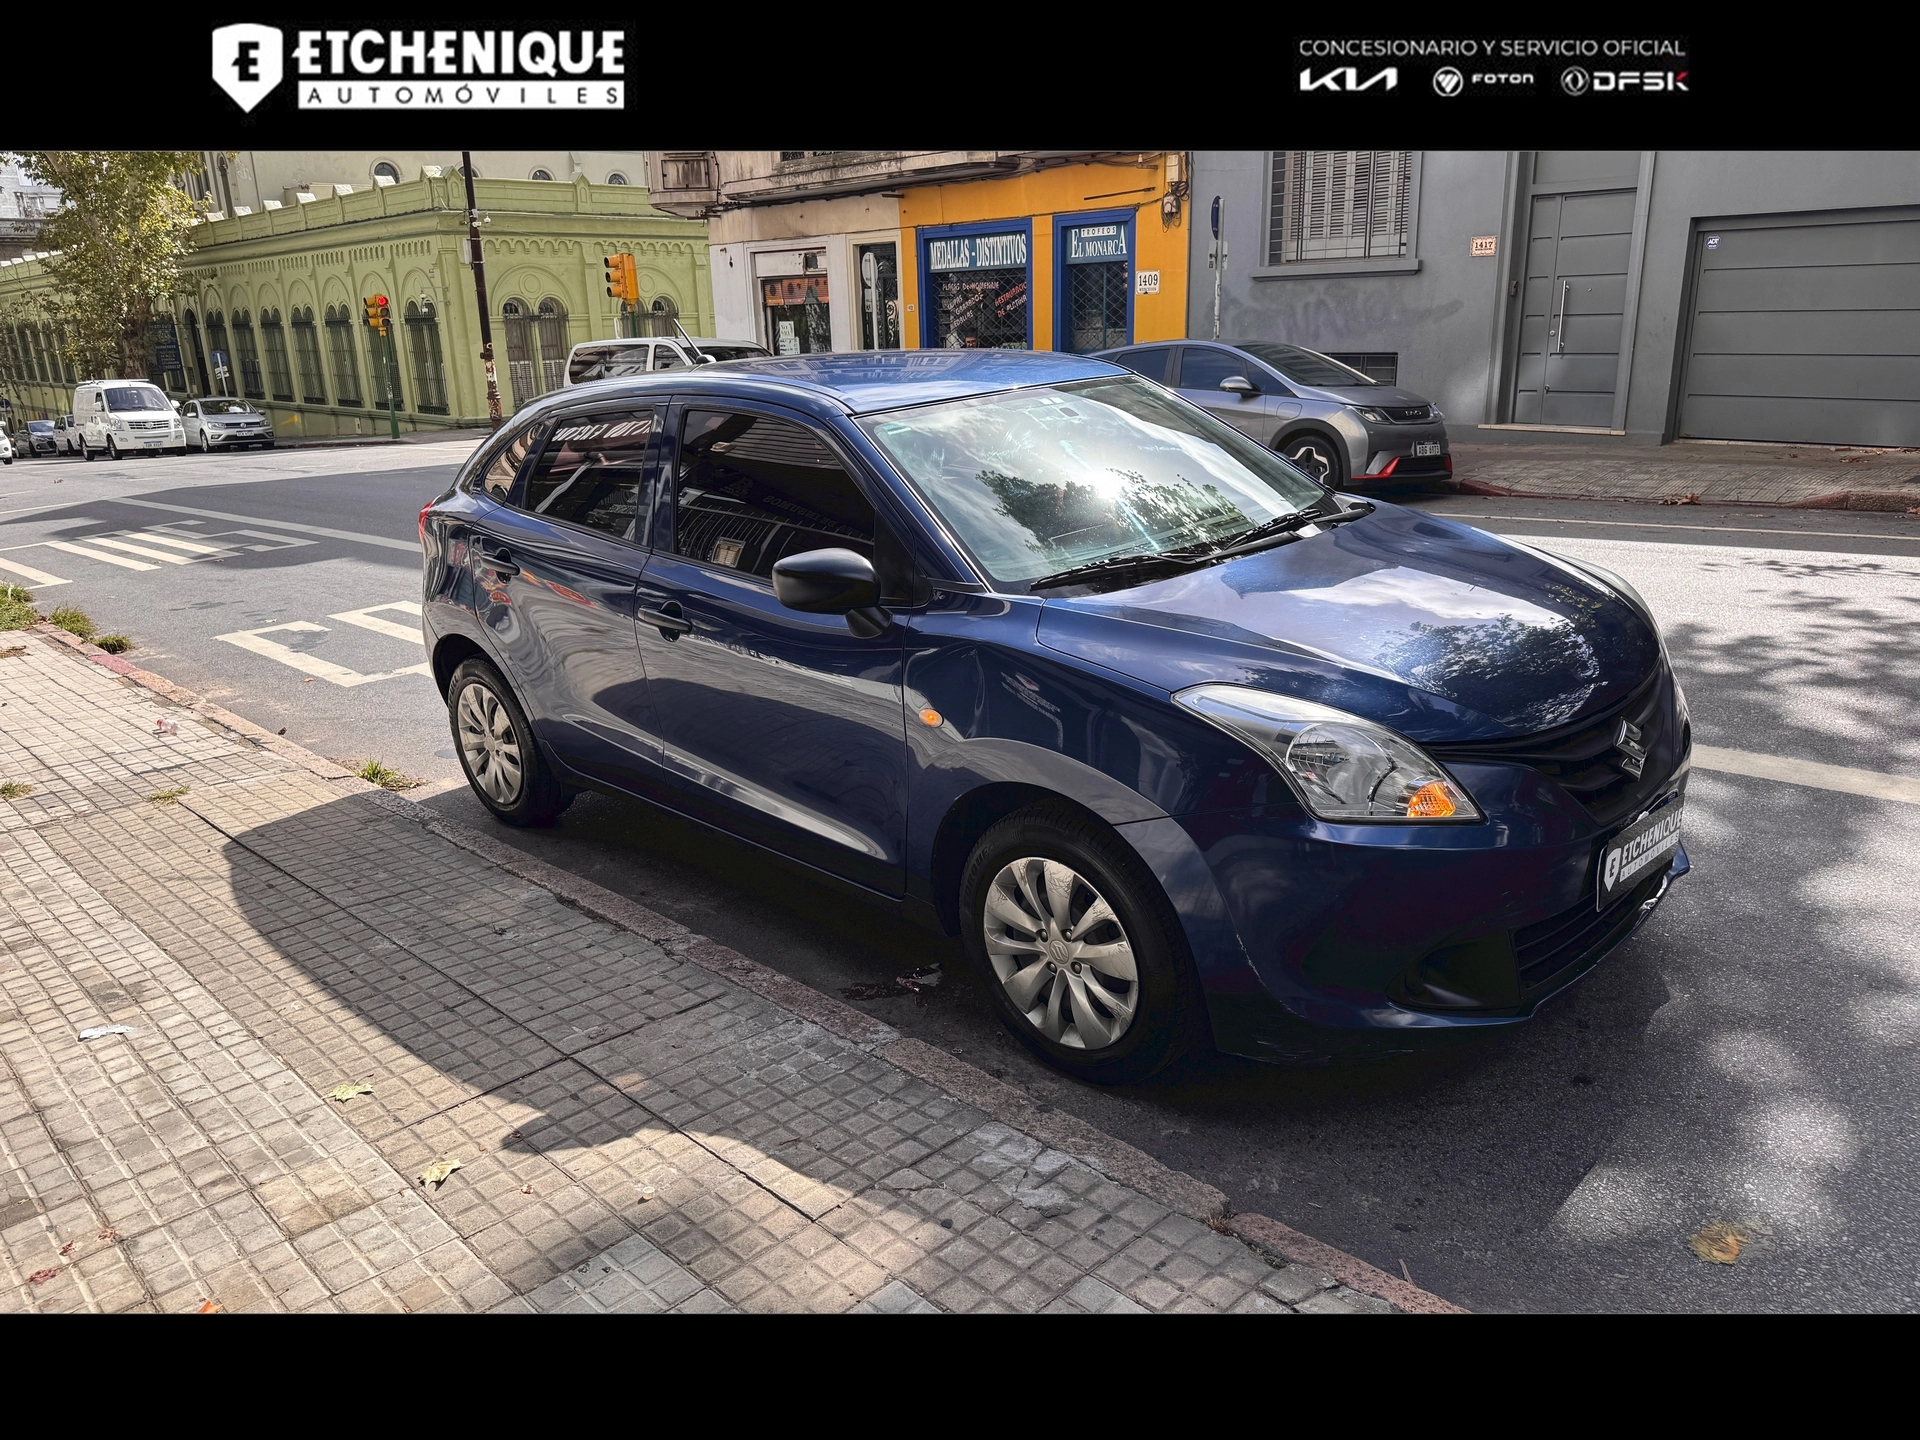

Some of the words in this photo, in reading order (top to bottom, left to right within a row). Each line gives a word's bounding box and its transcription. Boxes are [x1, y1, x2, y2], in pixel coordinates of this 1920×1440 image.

[1082, 227, 1116, 236] TROFEOS
[1085, 225, 1127, 257] MONARCA
[930, 239, 970, 270] MEDALLAS
[976, 233, 1027, 267] DISTINTIVOS
[1138, 273, 1158, 287] 1409
[1621, 808, 1683, 866] ETCHENIQUE
